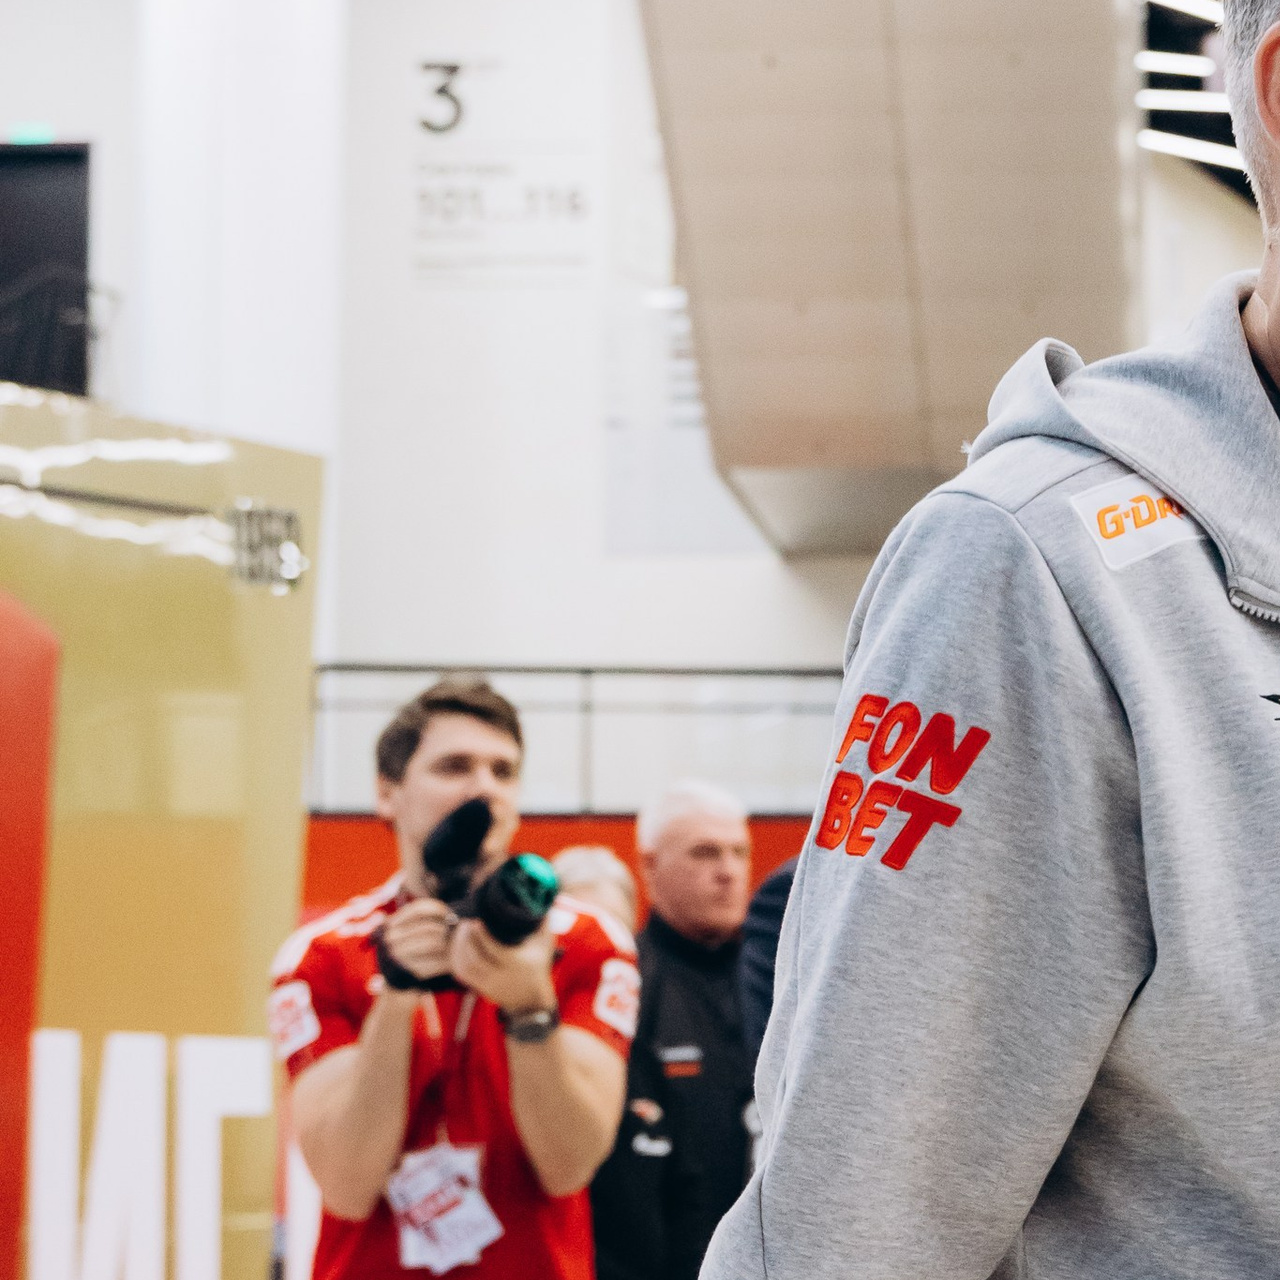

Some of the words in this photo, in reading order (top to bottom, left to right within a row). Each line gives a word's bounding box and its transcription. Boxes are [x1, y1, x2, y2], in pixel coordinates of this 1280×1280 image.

[419, 61, 464, 133] 3
[835, 693, 991, 795] FON
[815, 770, 963, 871] BET
